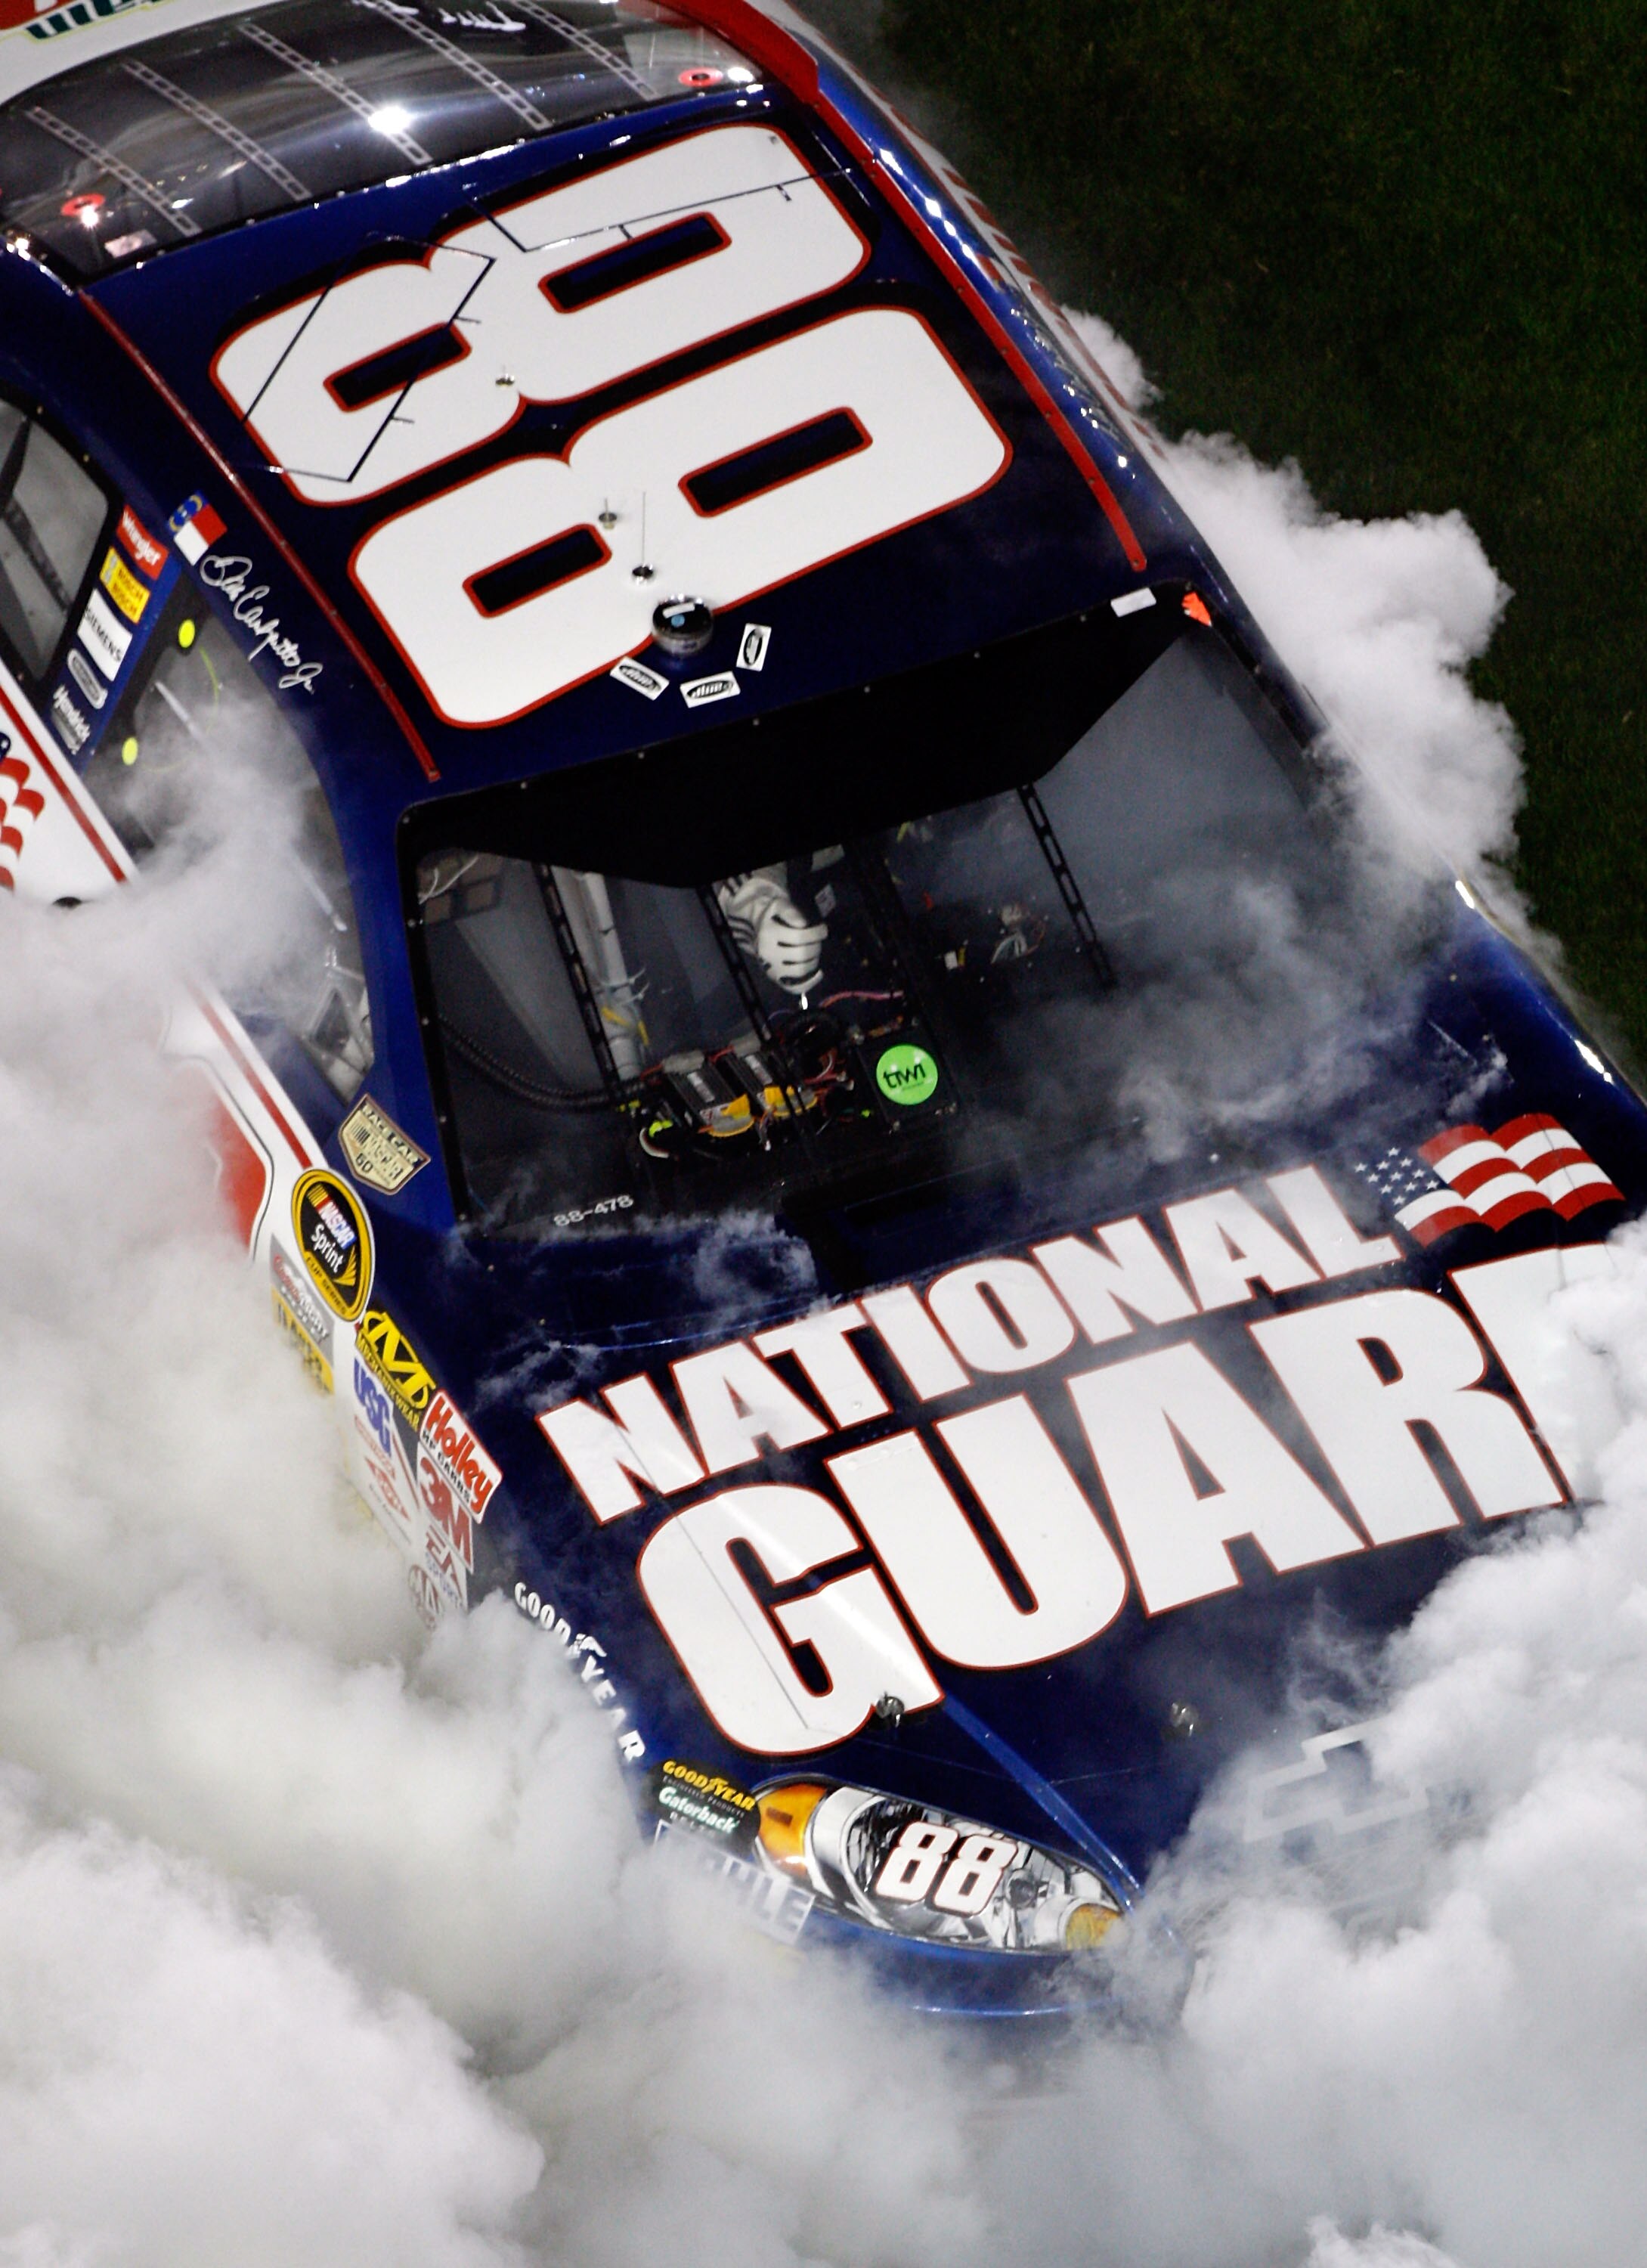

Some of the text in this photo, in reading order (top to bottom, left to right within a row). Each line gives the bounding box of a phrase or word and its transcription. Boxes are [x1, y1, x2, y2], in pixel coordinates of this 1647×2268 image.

[209, 122, 1013, 730] 88
[85, 607, 122, 662] SIEMENS
[318, 1201, 359, 1250] NASCAR
[553, 1194, 634, 1226] 88-478
[311, 1224, 343, 1273] Sprint
[536, 1165, 1403, 1526] NATIONAL
[354, 1357, 391, 1458] USG
[426, 1395, 493, 1514] Holley
[420, 1457, 472, 1568] 3M
[658, 1786, 741, 1834] Gatorback
[662, 1760, 756, 1811] GOODYEAR
[875, 1820, 1019, 1918] 88
